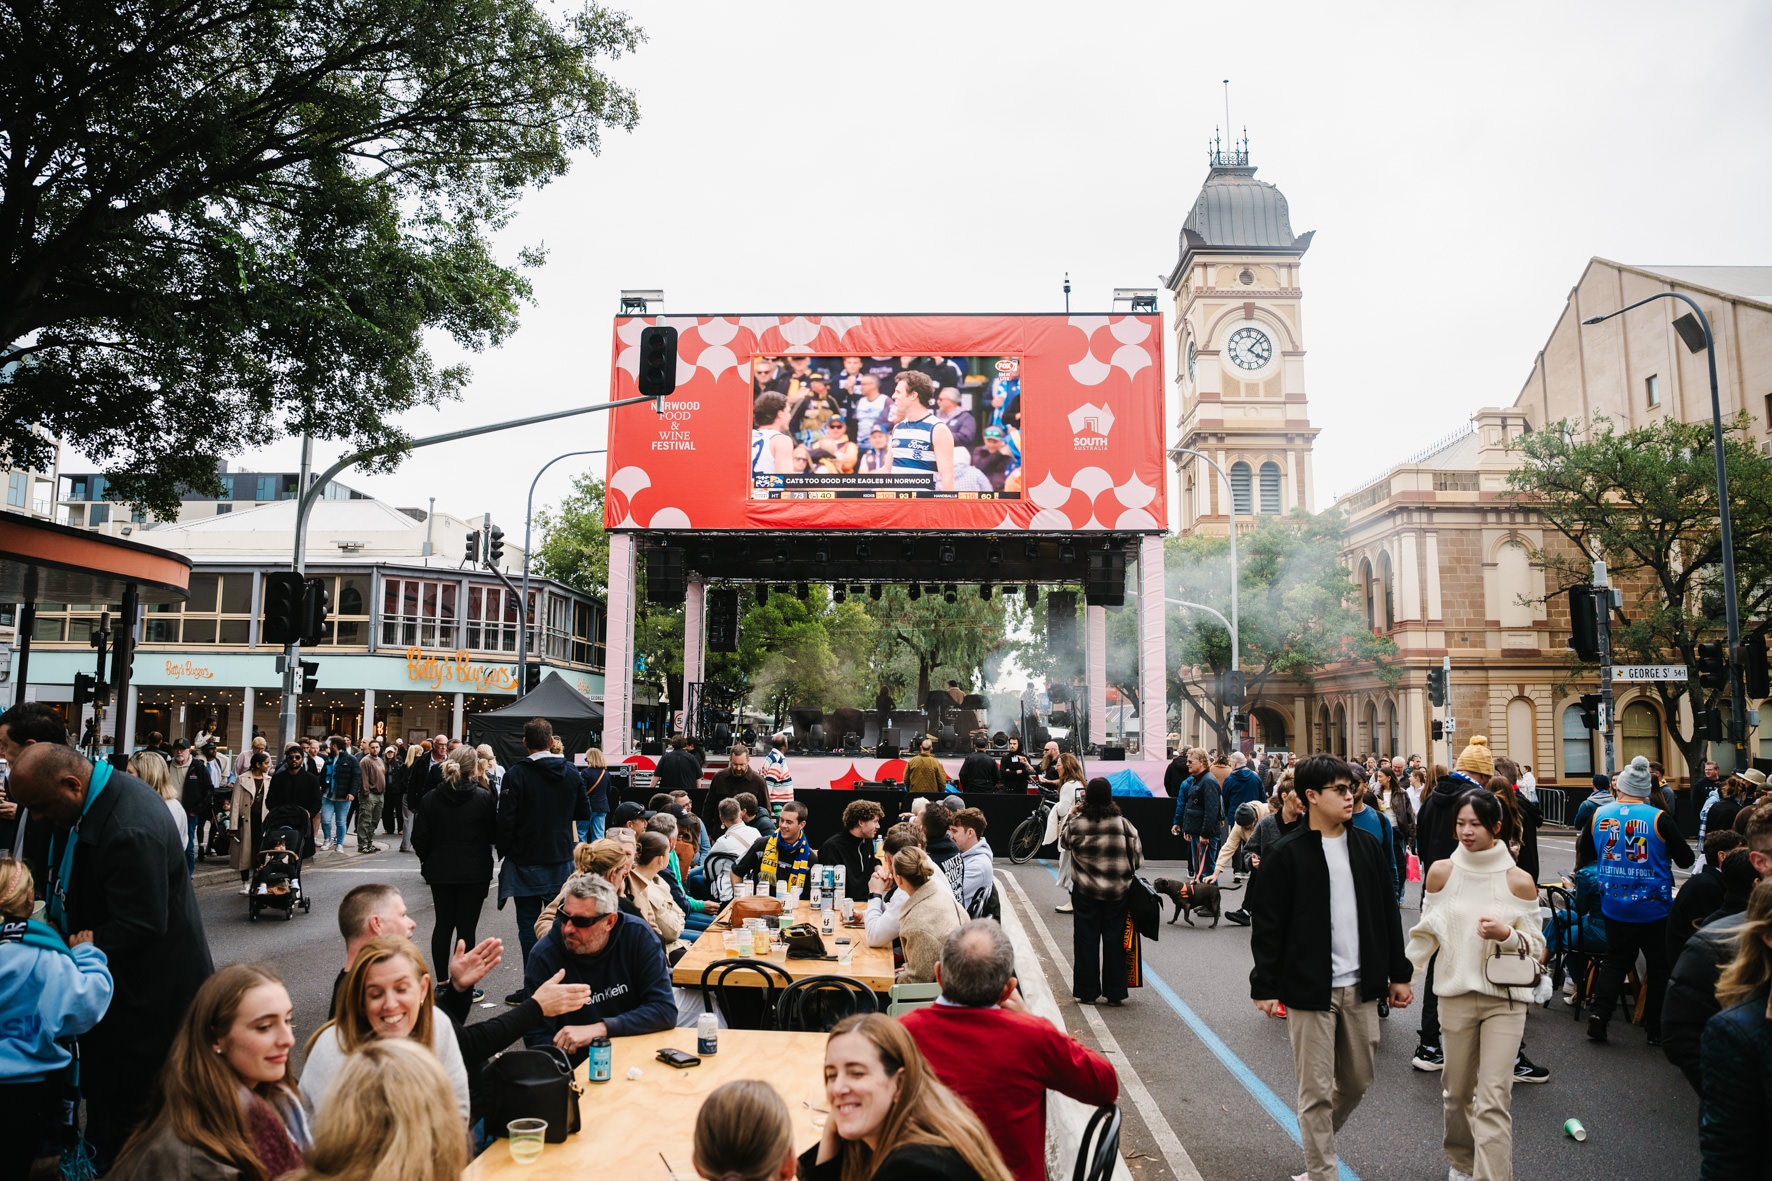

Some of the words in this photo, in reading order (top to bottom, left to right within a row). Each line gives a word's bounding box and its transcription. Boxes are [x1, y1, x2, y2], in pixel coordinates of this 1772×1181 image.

[651, 401, 700, 410] NRWOOD
[660, 411, 691, 420] FOOD
[670, 421, 680, 430] &
[659, 431, 690, 440] WINE
[651, 441, 696, 450] FESTIVAL
[907, 439, 930, 450] Ford
[1073, 437, 1108, 446] SOUTH
[165, 660, 185, 679] Betty's
[185, 660, 214, 679] Burgers
[406, 646, 453, 690] Betty's
[455, 649, 518, 691] Burgers
[1628, 668, 1660, 679] GEORGE
[1673, 669, 1686, 677] 54-1
[1627, 867, 1635, 876] OF
[1635, 868, 1655, 877] FOOTY
